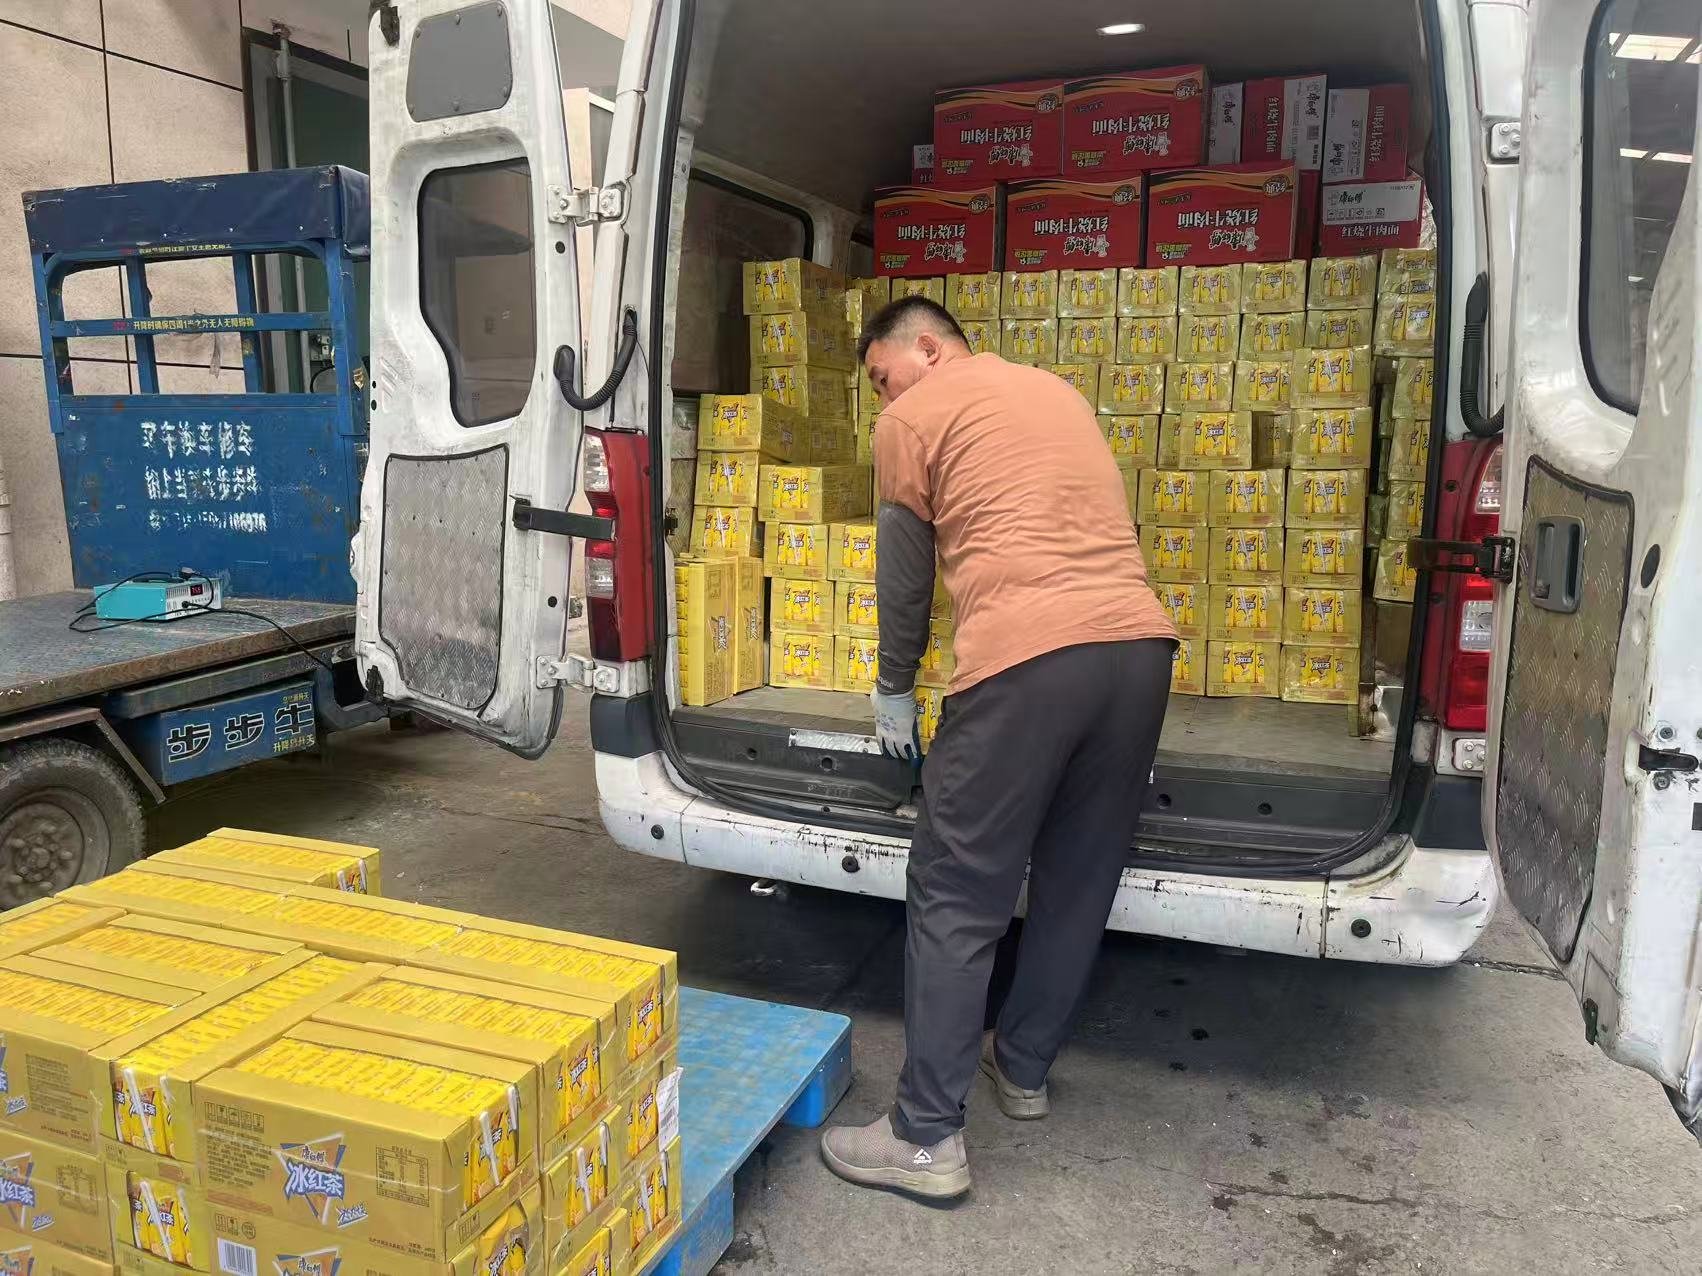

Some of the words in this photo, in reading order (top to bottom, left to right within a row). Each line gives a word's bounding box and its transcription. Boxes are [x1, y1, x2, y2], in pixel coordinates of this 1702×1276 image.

[960, 124, 1033, 145] 红烧牛肉面
[1091, 112, 1171, 136] 红烧牛肉面
[1033, 216, 1109, 237] 红烧牛肉面
[1176, 208, 1259, 229] 红烧牛肉面
[897, 223, 966, 241] 红烧牛肉面
[167, 703, 315, 763] 步步牛
[285, 1161, 344, 1197] 冰红茶
